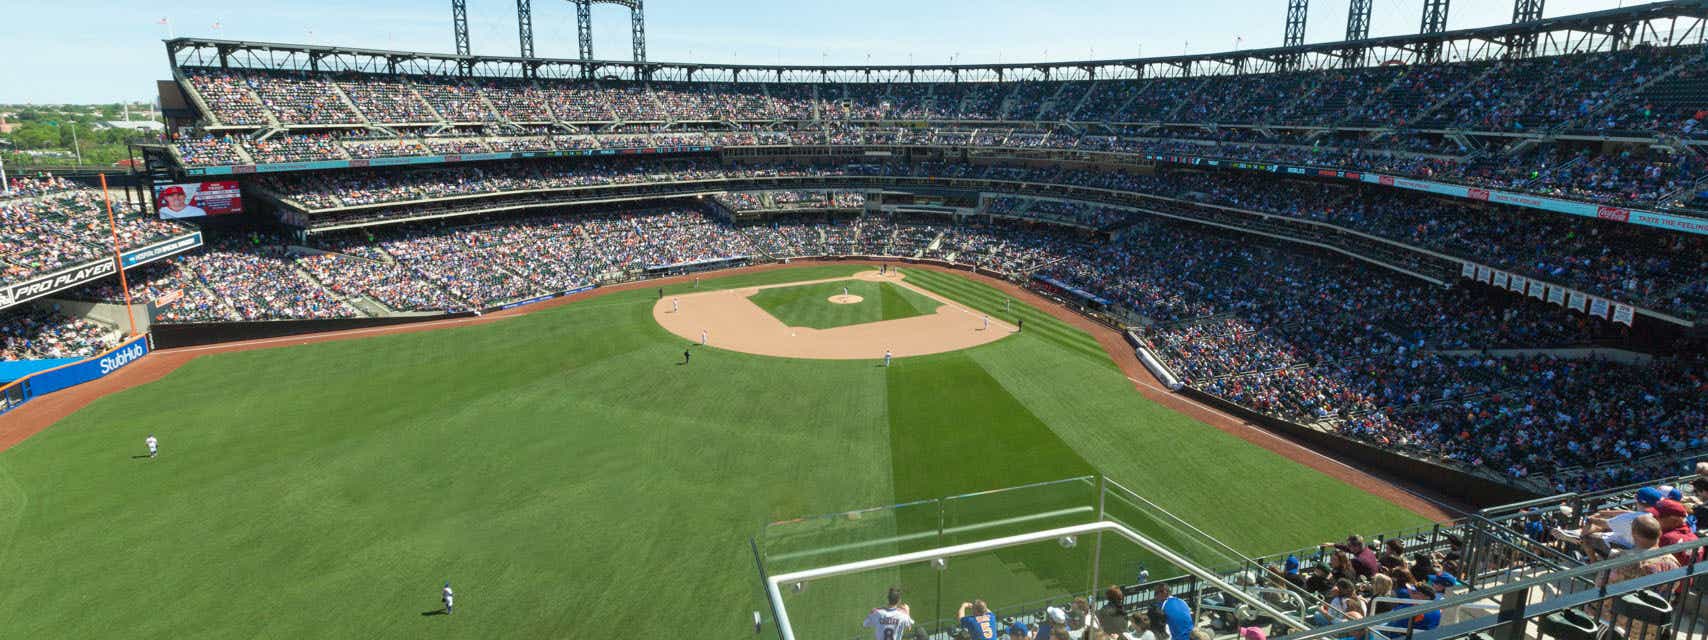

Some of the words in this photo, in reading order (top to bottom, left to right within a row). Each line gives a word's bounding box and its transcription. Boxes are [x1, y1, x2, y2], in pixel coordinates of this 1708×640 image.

[1639, 215, 1659, 225] TASTE
[1661, 218, 1674, 226] THE
[15, 279, 53, 300] PRO
[53, 261, 113, 288] PLAYER
[100, 343, 143, 374] StubHub
[980, 622, 993, 639] 5
